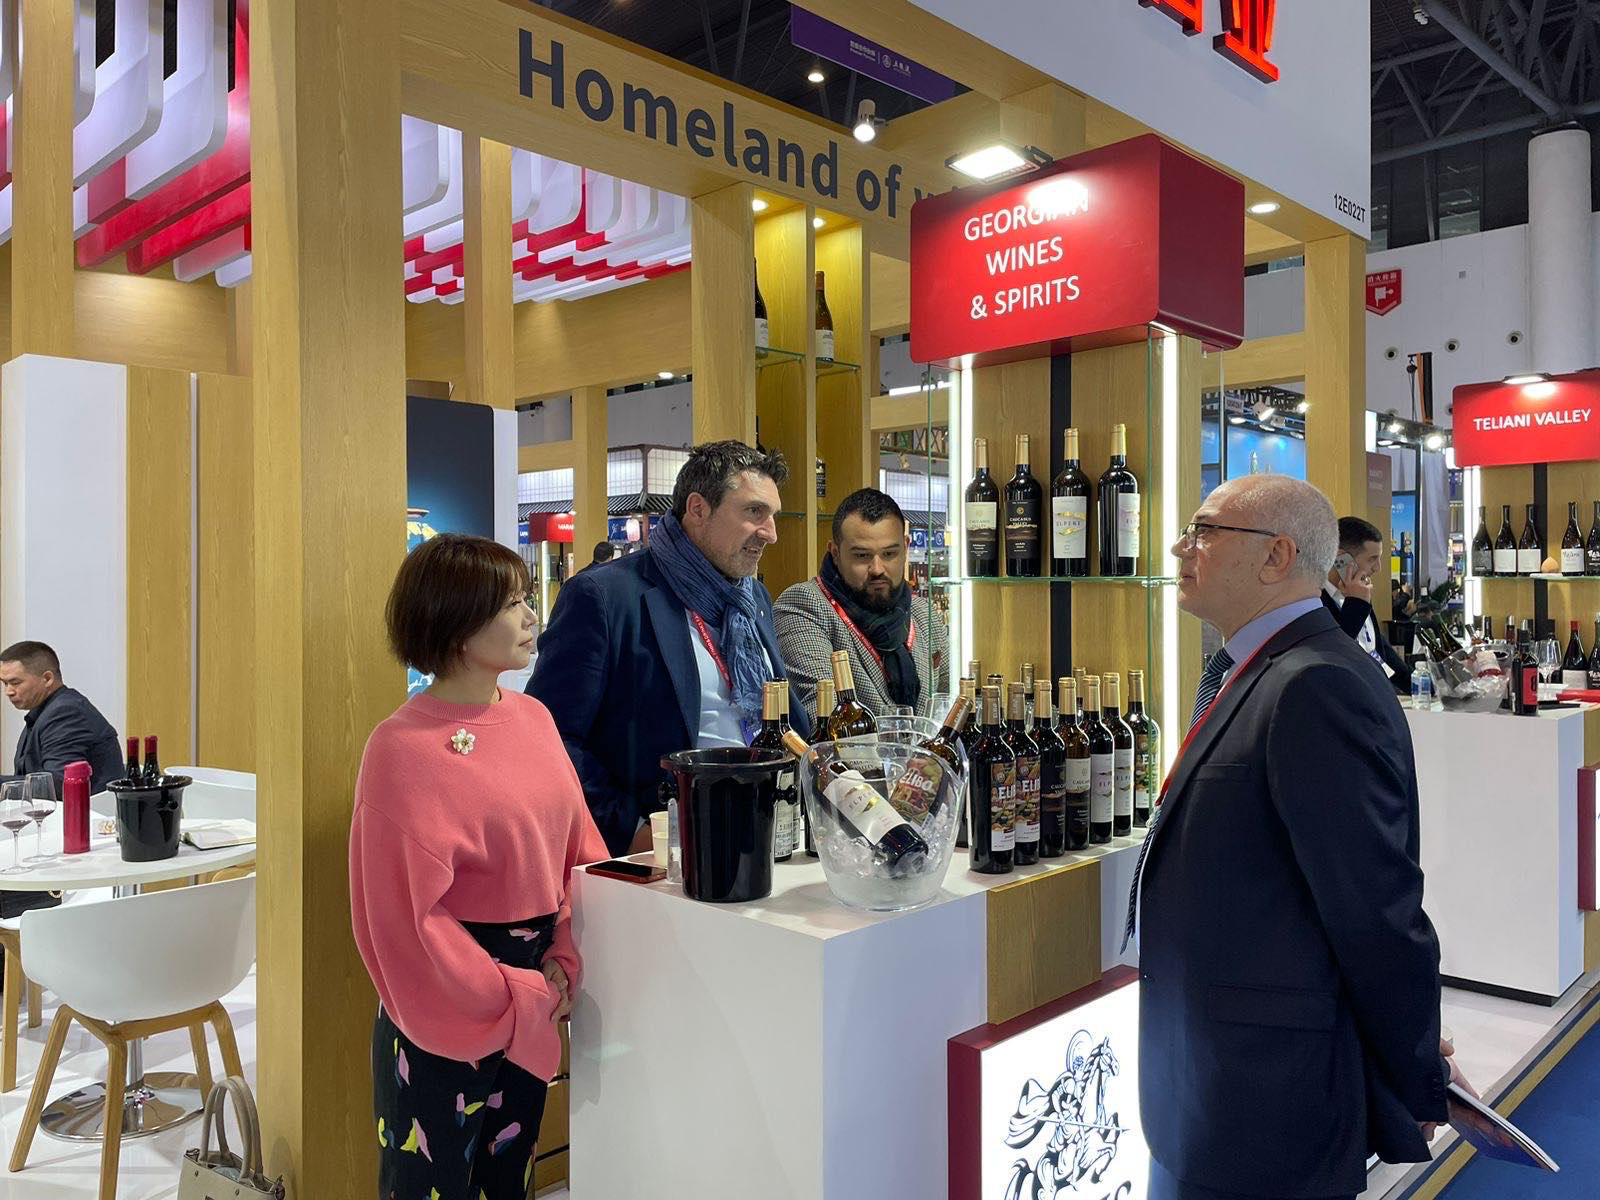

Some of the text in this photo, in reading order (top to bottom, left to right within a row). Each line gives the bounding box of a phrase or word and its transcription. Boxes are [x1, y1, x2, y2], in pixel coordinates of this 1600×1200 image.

[518, 28, 902, 218] Homeland of
[964, 190, 1089, 241] GEORGN
[1333, 193, 1366, 223] 12E022T
[985, 236, 1064, 276] WINES
[970, 275, 1081, 320] & SPIRITS
[1473, 408, 1592, 431] TELIANI VALLEY
[900, 768, 933, 791] ELIBO
